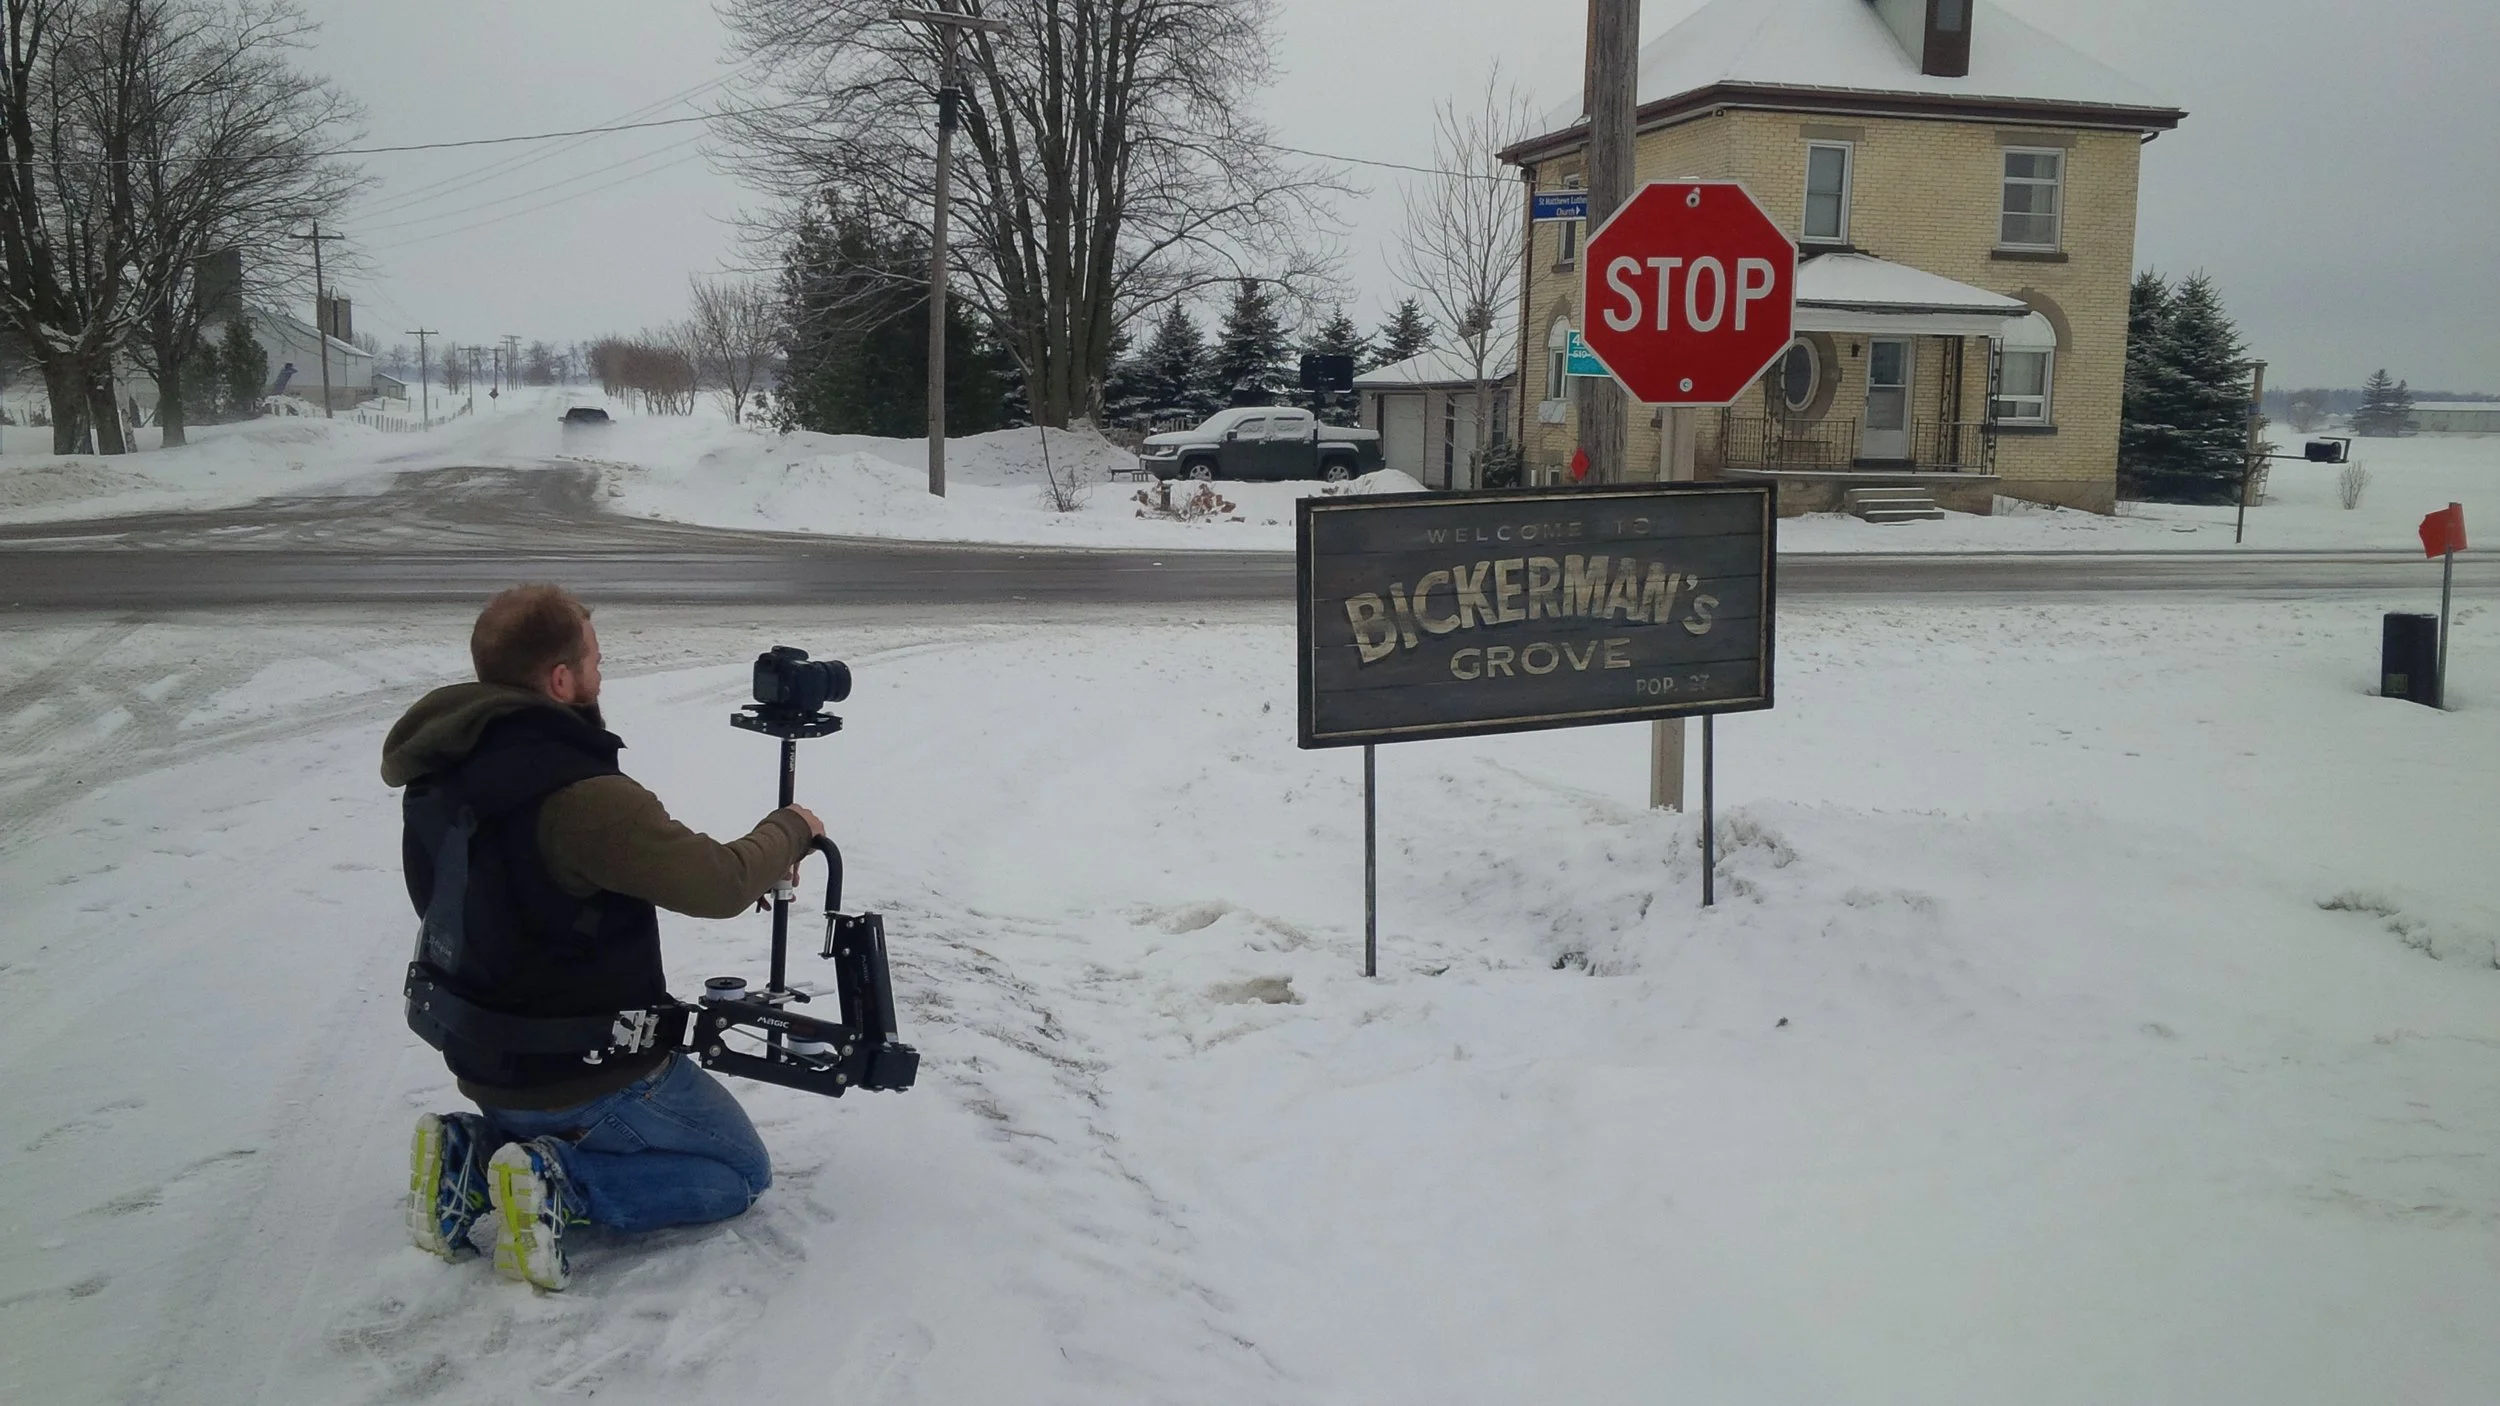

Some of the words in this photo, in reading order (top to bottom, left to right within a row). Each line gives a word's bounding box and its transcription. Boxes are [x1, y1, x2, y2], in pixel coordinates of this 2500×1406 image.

[1603, 255, 1775, 332] STOP
[1427, 521, 1583, 544] WELCOME
[1613, 517, 1650, 535] TO
[1448, 637, 1632, 681] GROVE
[1636, 676, 1679, 695] POP.
[756, 1016, 790, 1029] MAGIC
